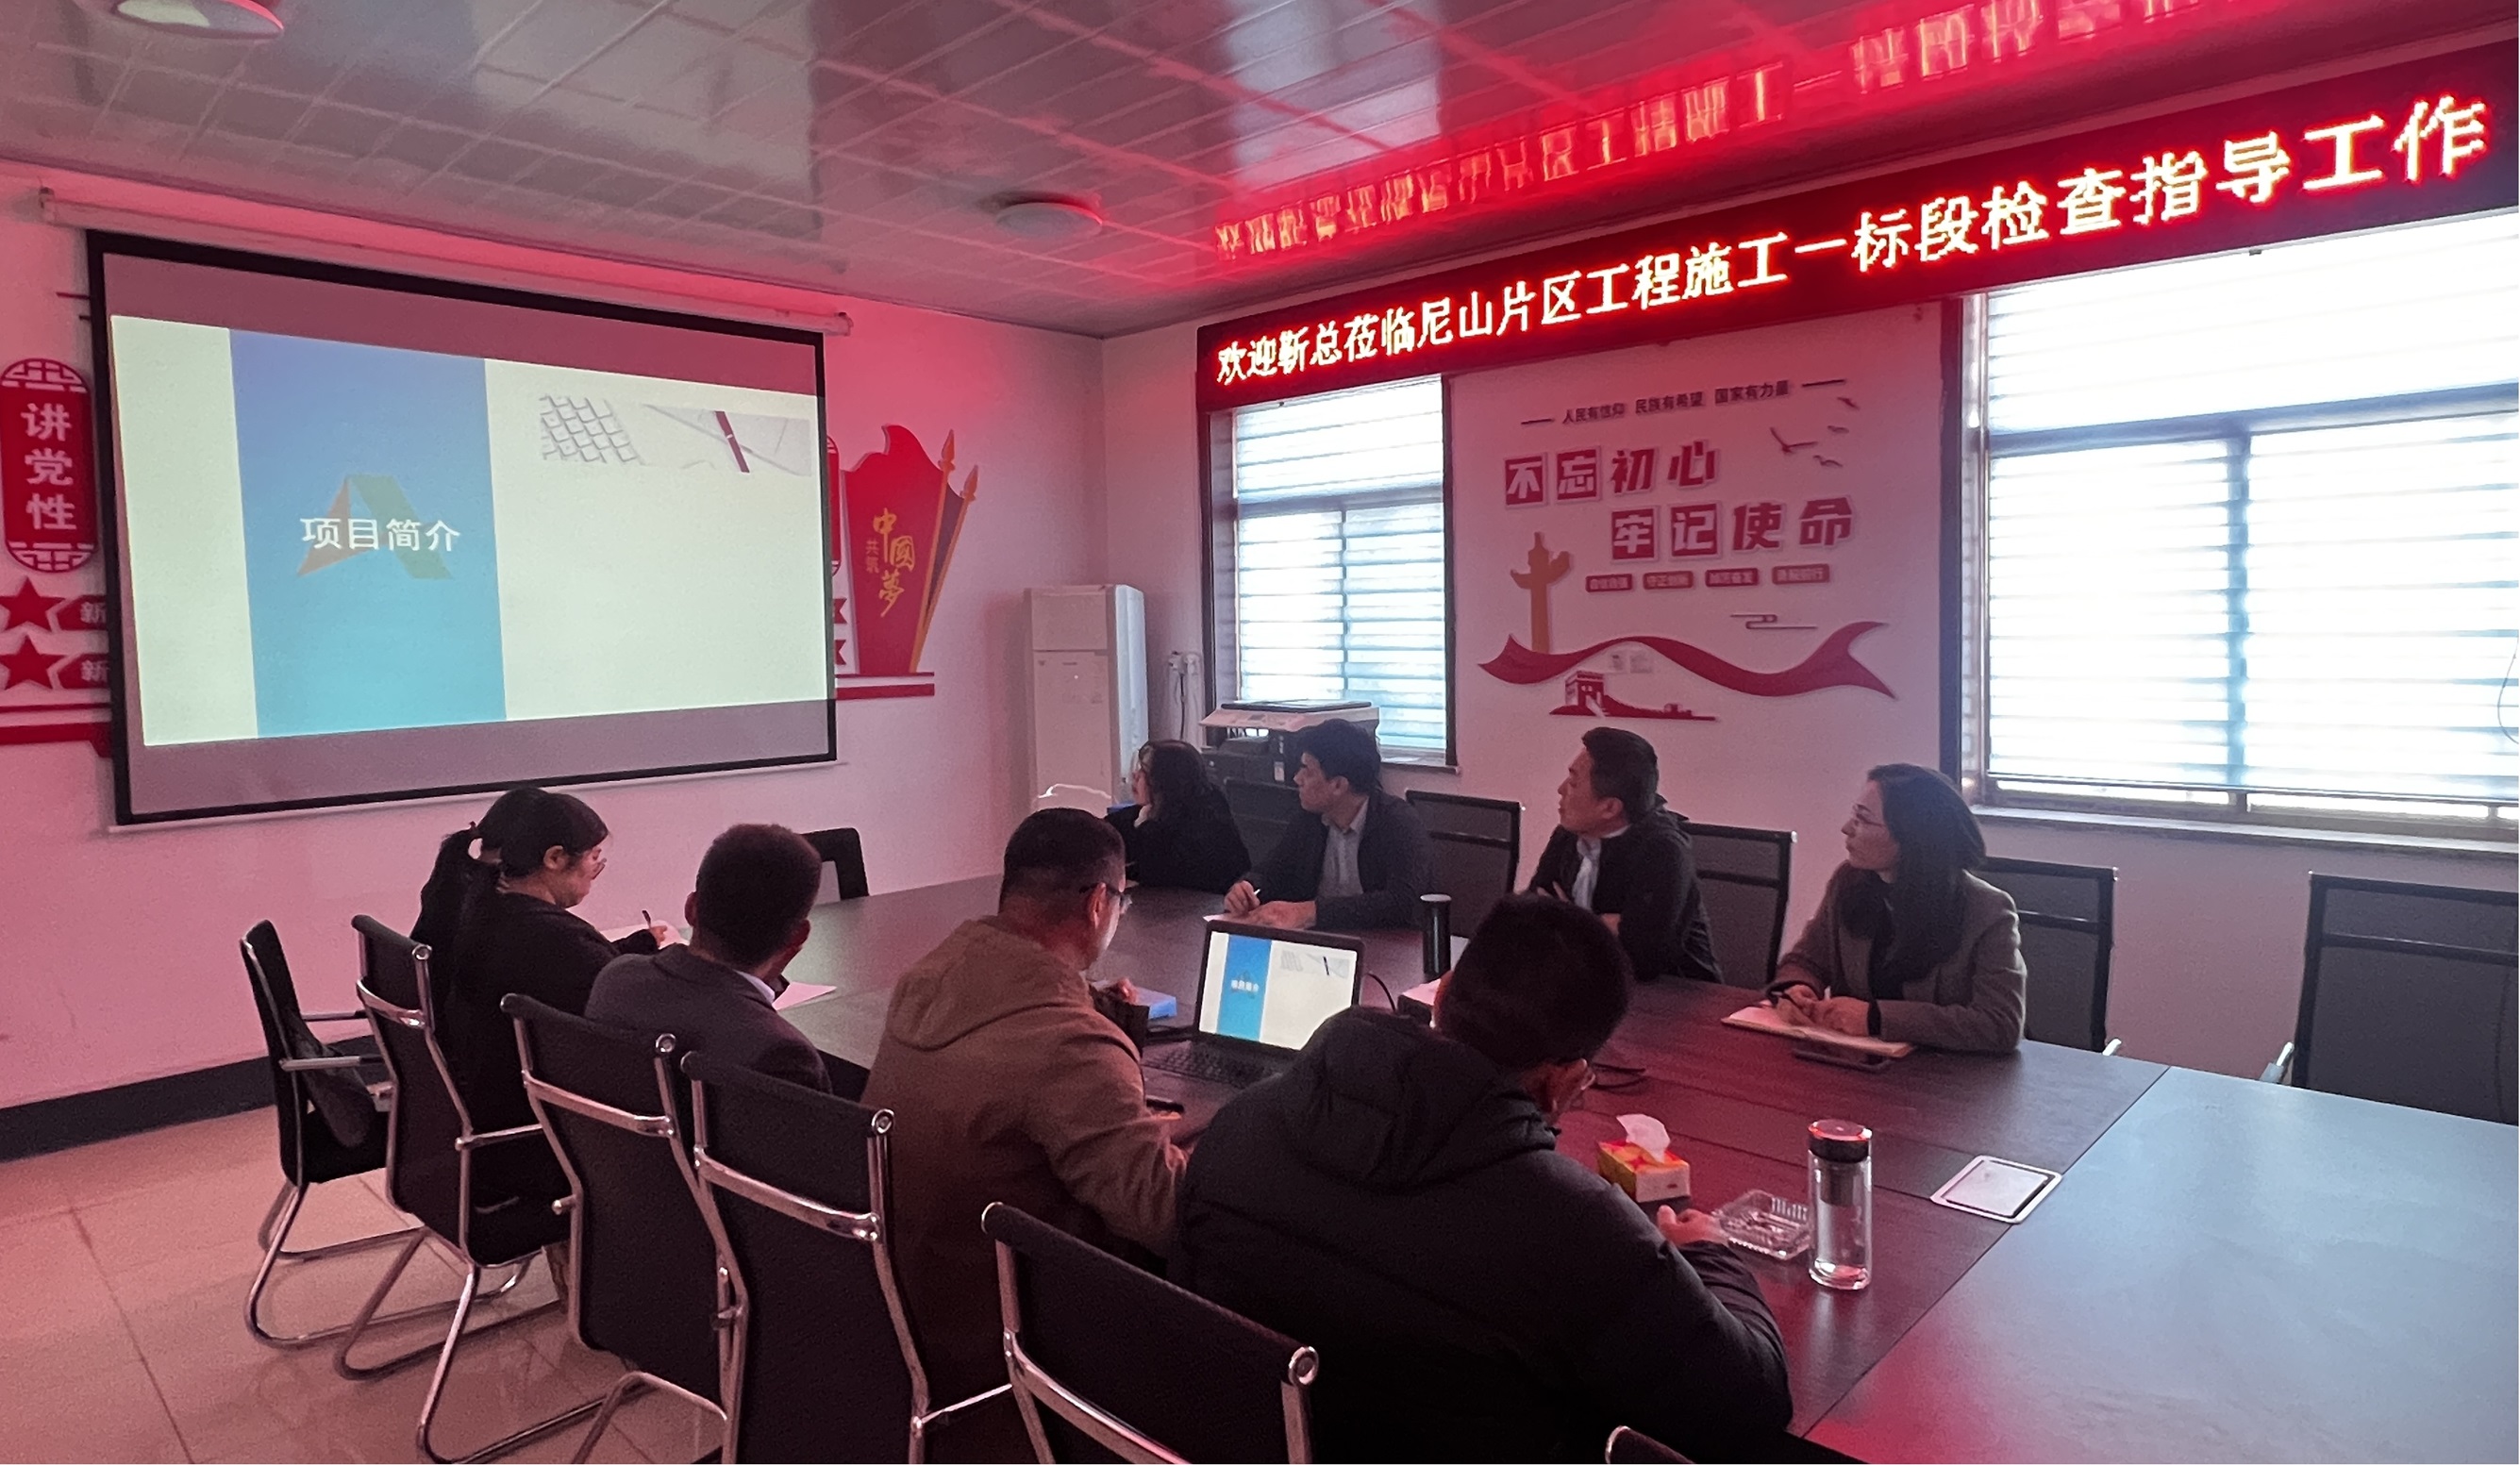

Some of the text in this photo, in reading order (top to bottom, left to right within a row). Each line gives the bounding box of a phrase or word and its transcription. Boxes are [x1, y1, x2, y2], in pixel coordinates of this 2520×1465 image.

[1562, 380, 1789, 425] 人民有信仰 民族有希望 国家有力量
[21, 403, 77, 530] 讲党性
[1507, 441, 1718, 504] 不忘初心
[300, 518, 460, 552] 项目简介
[1612, 496, 1853, 558] 牢记使命
